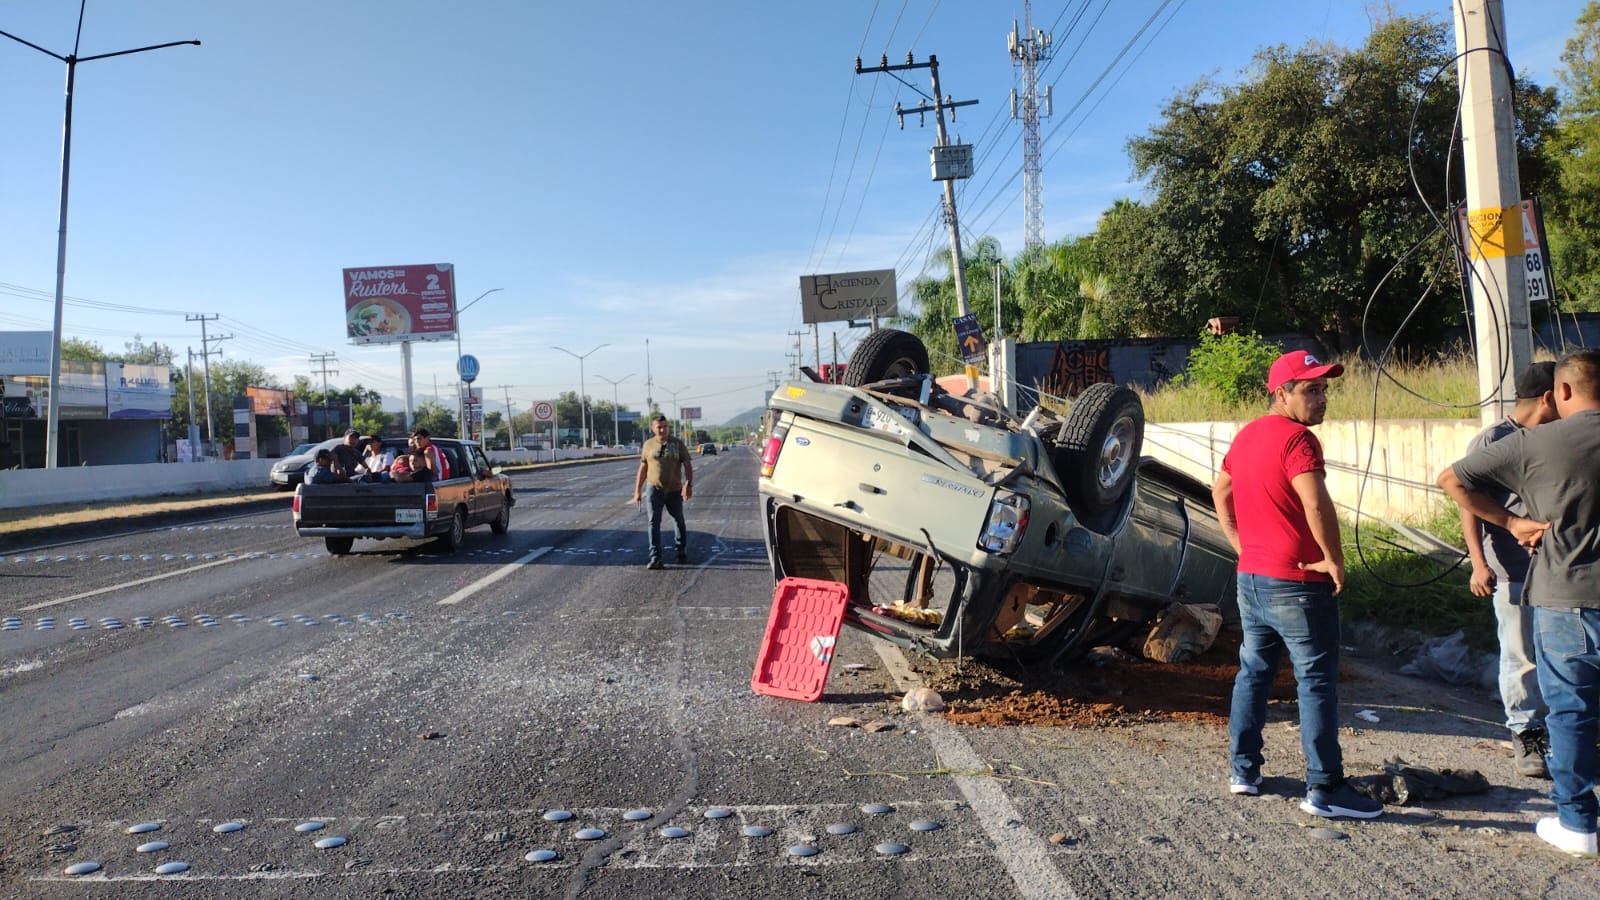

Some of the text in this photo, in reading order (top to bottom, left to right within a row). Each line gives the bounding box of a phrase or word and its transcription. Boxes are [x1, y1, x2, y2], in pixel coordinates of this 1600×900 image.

[1526, 252, 1542, 273] 68
[349, 270, 394, 281] VAMOS
[425, 274, 440, 290] 2
[349, 280, 409, 297] Rusters
[812, 275, 880, 295] HACIENDA
[818, 289, 888, 310] CRISTALES
